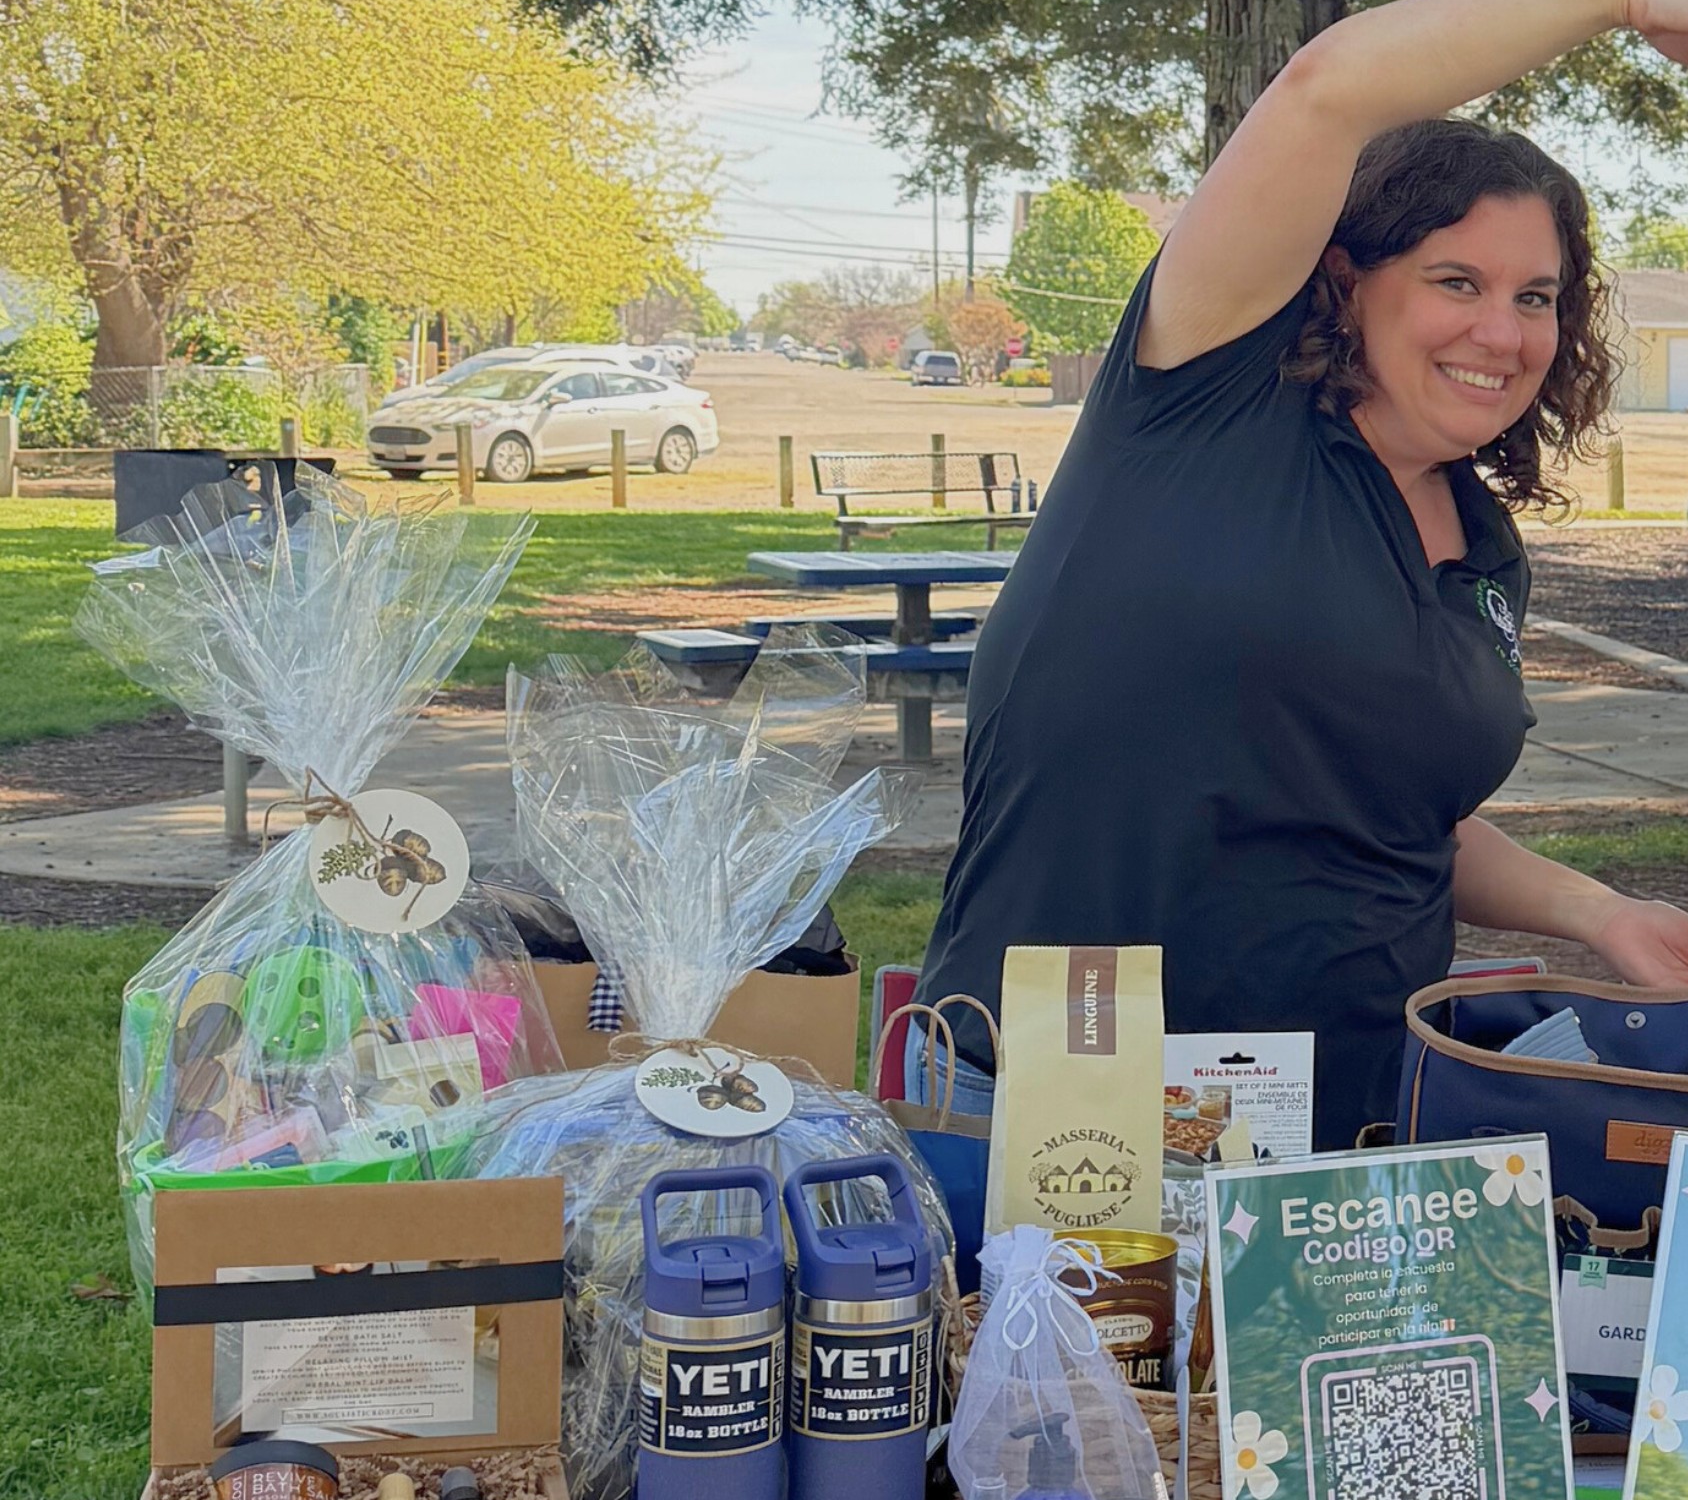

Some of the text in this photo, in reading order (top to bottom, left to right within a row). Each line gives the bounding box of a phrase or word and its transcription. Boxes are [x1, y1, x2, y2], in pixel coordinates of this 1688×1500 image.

[1084, 969, 1098, 1046] LINGUINE
[1194, 1066, 1279, 1077] KitchenAid
[1043, 1128, 1125, 1154] MASSERIA
[1043, 1202, 1122, 1229] PUGLIESE
[1281, 1187, 1478, 1237] Escanee
[1303, 1226, 1456, 1265] Codigo QR
[1313, 1260, 1455, 1287] Completa la encuesta
[1345, 1283, 1427, 1305] para tener la
[1336, 1302, 1438, 1325] oportunidad de
[1096, 1322, 1151, 1339] OLCETTO
[1318, 1328, 1380, 1349] participar
[1384, 1326, 1400, 1338] en
[814, 1344, 910, 1379] YETI
[670, 1357, 770, 1397] YETI
[823, 1386, 895, 1400] RAMBLER
[682, 1401, 756, 1417] RAMBLER
[811, 1403, 909, 1422] 18oz BOTTLE
[668, 1417, 769, 1439] 18oz BOTTLE
